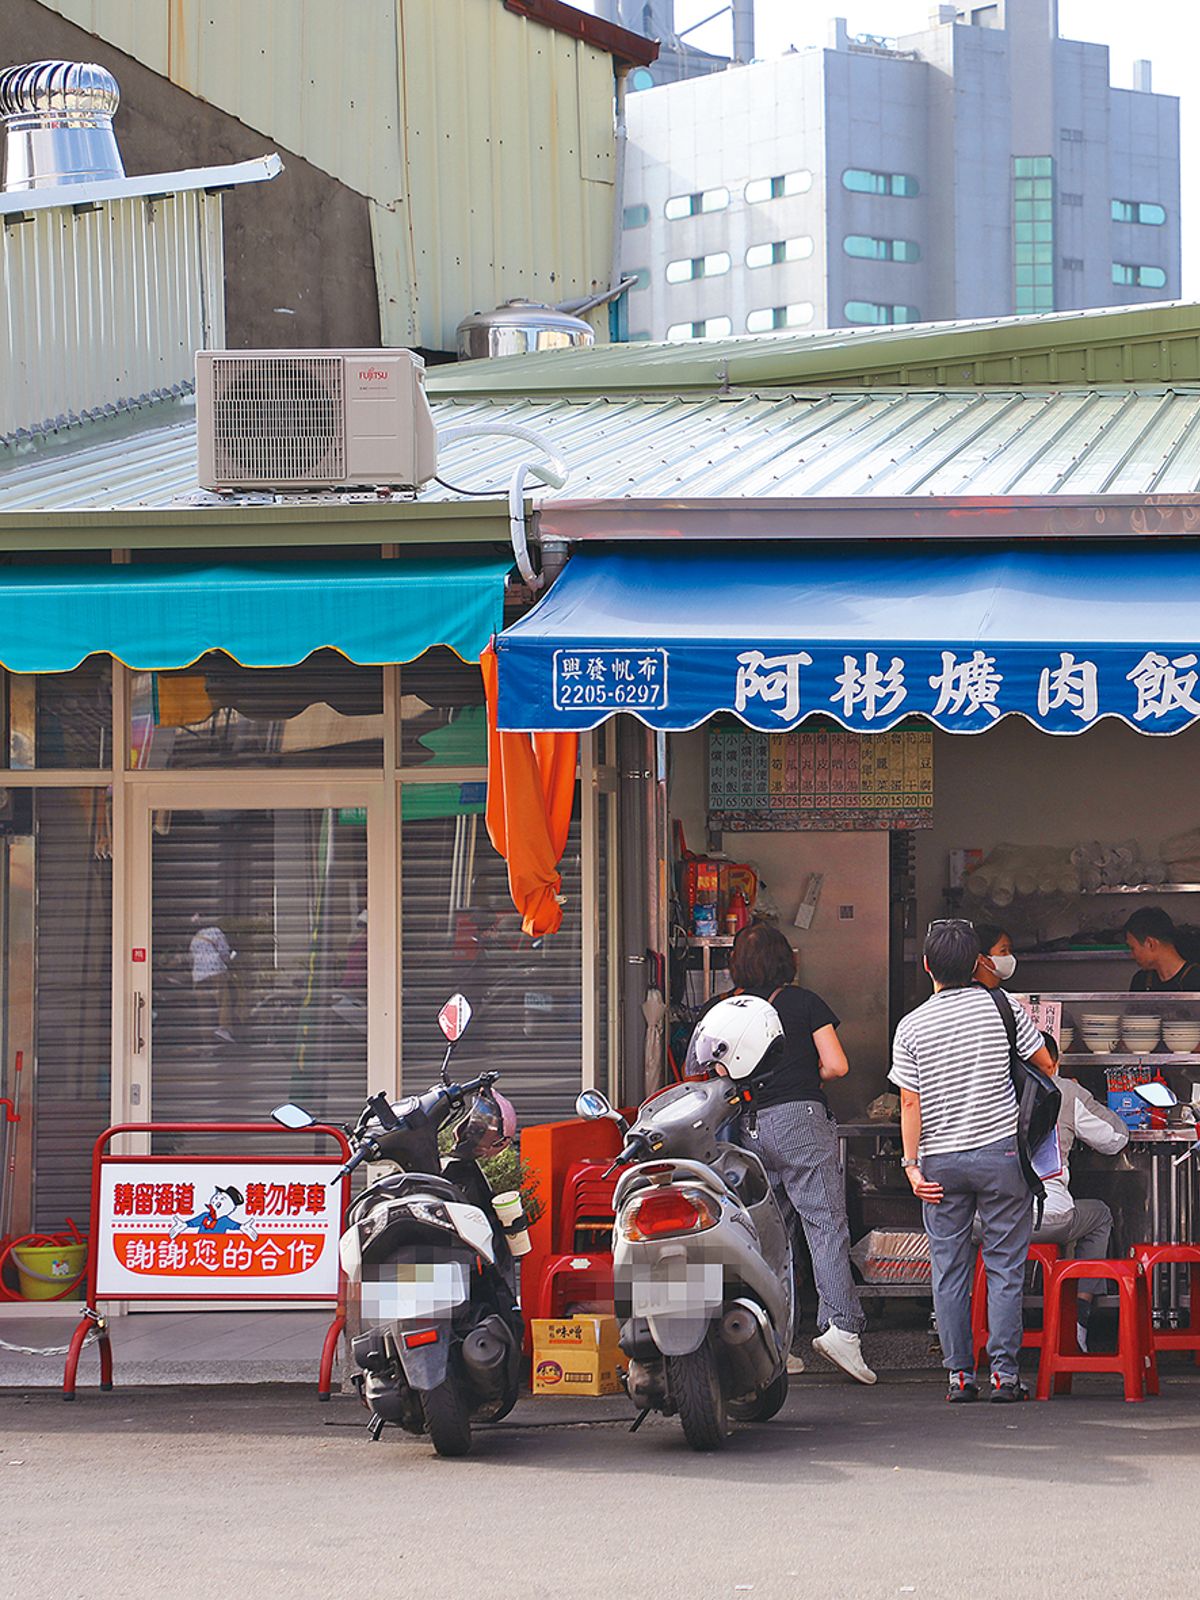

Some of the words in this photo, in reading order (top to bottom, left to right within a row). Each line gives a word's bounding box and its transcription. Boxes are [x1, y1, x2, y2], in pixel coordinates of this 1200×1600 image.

[359, 367, 389, 382] FUJITSU
[561, 656, 658, 682] 興發帆布
[560, 684, 660, 704] 2205-6297
[711, 797, 723, 807] 70
[726, 797, 738, 807] 65
[741, 797, 753, 807] 90
[756, 797, 768, 807] 85
[771, 797, 783, 807] 25
[786, 797, 798, 807] 25
[801, 797, 813, 807] 25
[816, 797, 828, 807] 25
[831, 796, 843, 806] 25
[846, 796, 859, 806] 35
[861, 796, 873, 806] 55
[876, 796, 888, 806] 20
[891, 796, 902, 806] 15
[905, 796, 917, 806] 20
[919, 796, 932, 806] 10
[113, 1182, 195, 1216] 請留通道
[245, 1182, 327, 1216] 請勿停車
[125, 1238, 317, 1270] 謝謝您的合作
